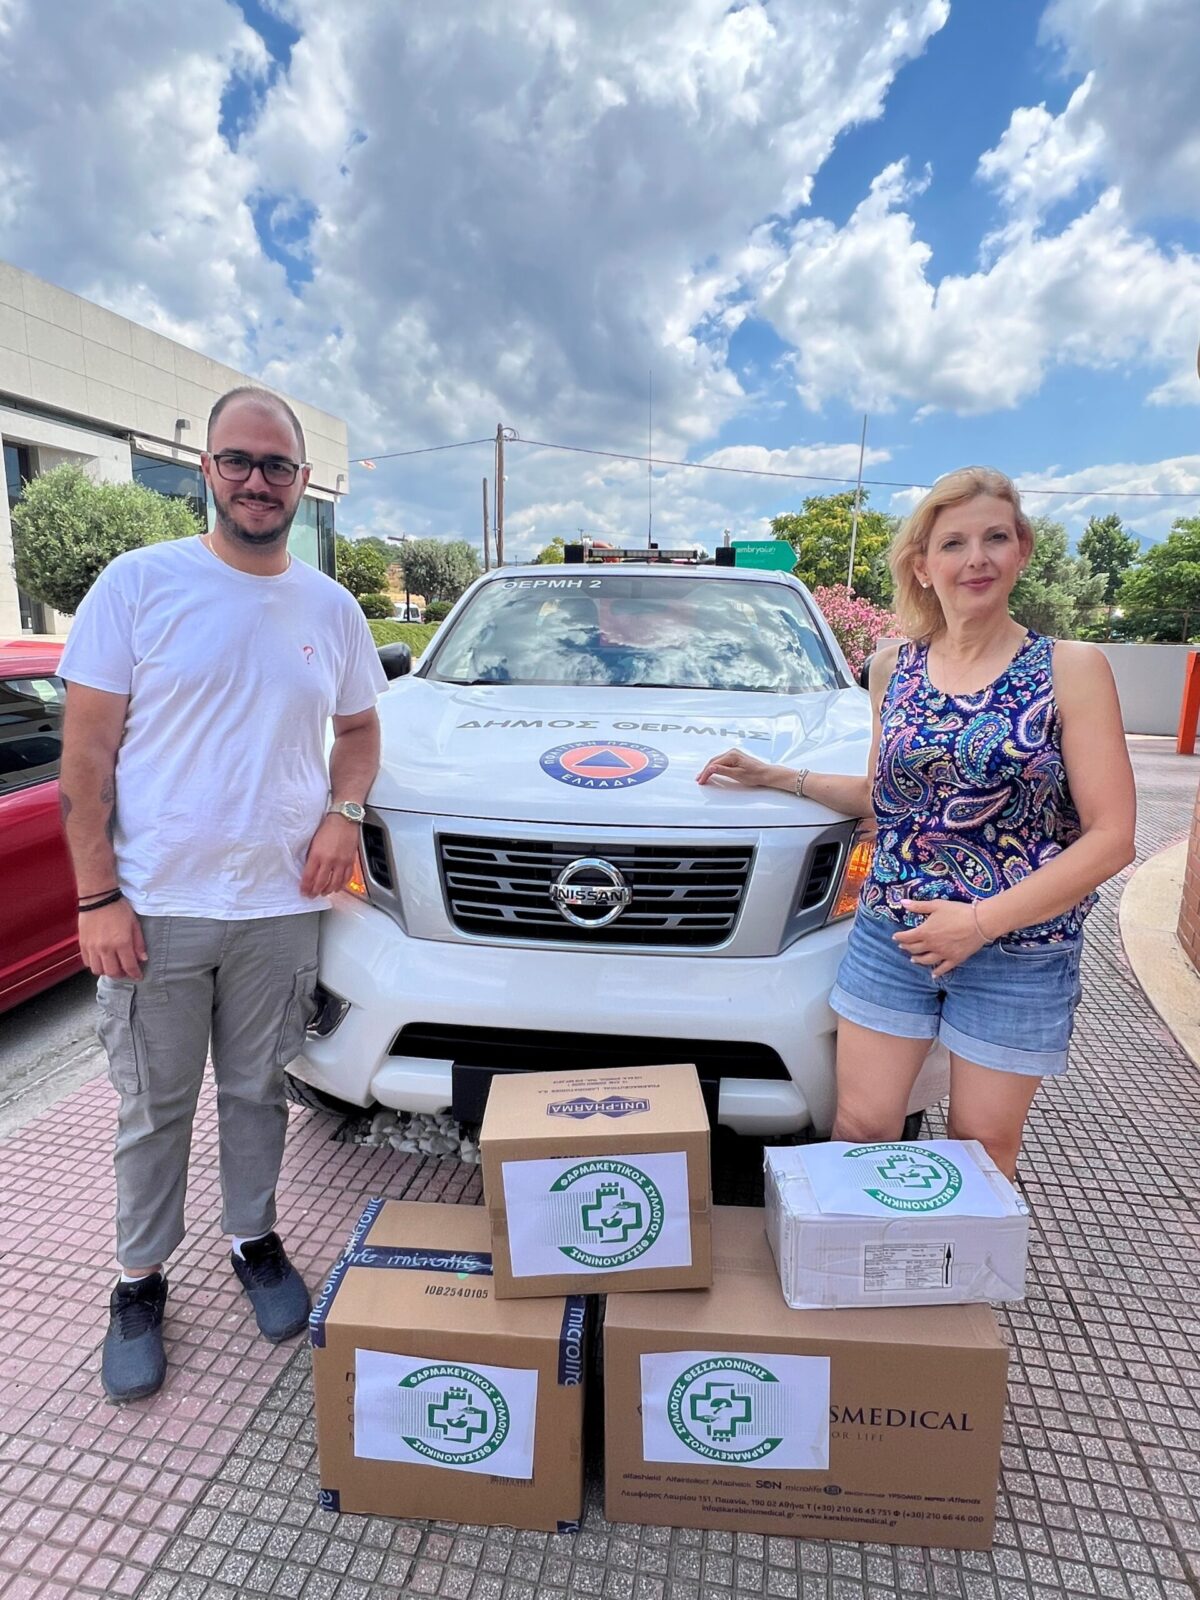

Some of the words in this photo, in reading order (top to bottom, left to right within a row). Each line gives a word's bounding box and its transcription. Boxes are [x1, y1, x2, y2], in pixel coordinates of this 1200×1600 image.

[502, 579, 583, 590] ΘΕΡΜΗ
[588, 579, 602, 589] 2
[455, 719, 599, 729] ΔΗΜΟΣ
[612, 721, 773, 741] ΘΕΡΜΗΣ
[561, 773, 637, 787] ΕΛΛΑΔΑ
[558, 888, 624, 902] NISSAN
[551, 1101, 645, 1113] UNI-PHARMA
[560, 1162, 646, 1187] ΦΑΡΜΑΚΕΥΤΙΚΟΣ
[876, 1187, 955, 1209] ΘΕΣΣΑΛΟΝΙΚΗΣ
[644, 1185, 662, 1238] ΣΥΛΛΟΓΟΣ
[569, 1239, 649, 1265] ΘΕΣΣΑΛΟΝΙΚΗΣ
[410, 1367, 495, 1395] ΦΑΡΜΑΚΕΥΤΙΚΟΣ
[684, 1360, 768, 1381] ΘΕΣΣΑΛΟΝΙΚΗΣ
[670, 1382, 687, 1434] ΣΥΛΛΟΓΟΣ
[491, 1396, 507, 1446] ΣΥΛΛΟΓΟΣ
[684, 1435, 771, 1461] ΦΑΡΜΑΚΕΥΤΙΚΟΣ
[857, 1432, 884, 1442] LIFE
[412, 1440, 492, 1462] ΘΕΣΣΑΛΟΝΙΚΗΣ
[813, 1503, 835, 1513] (+30)
[836, 1505, 851, 1513] 210
[853, 1507, 864, 1515] 66
[902, 1511, 925, 1520] (+30)
[926, 1512, 941, 1520] 210
[967, 1515, 984, 1523] 000
